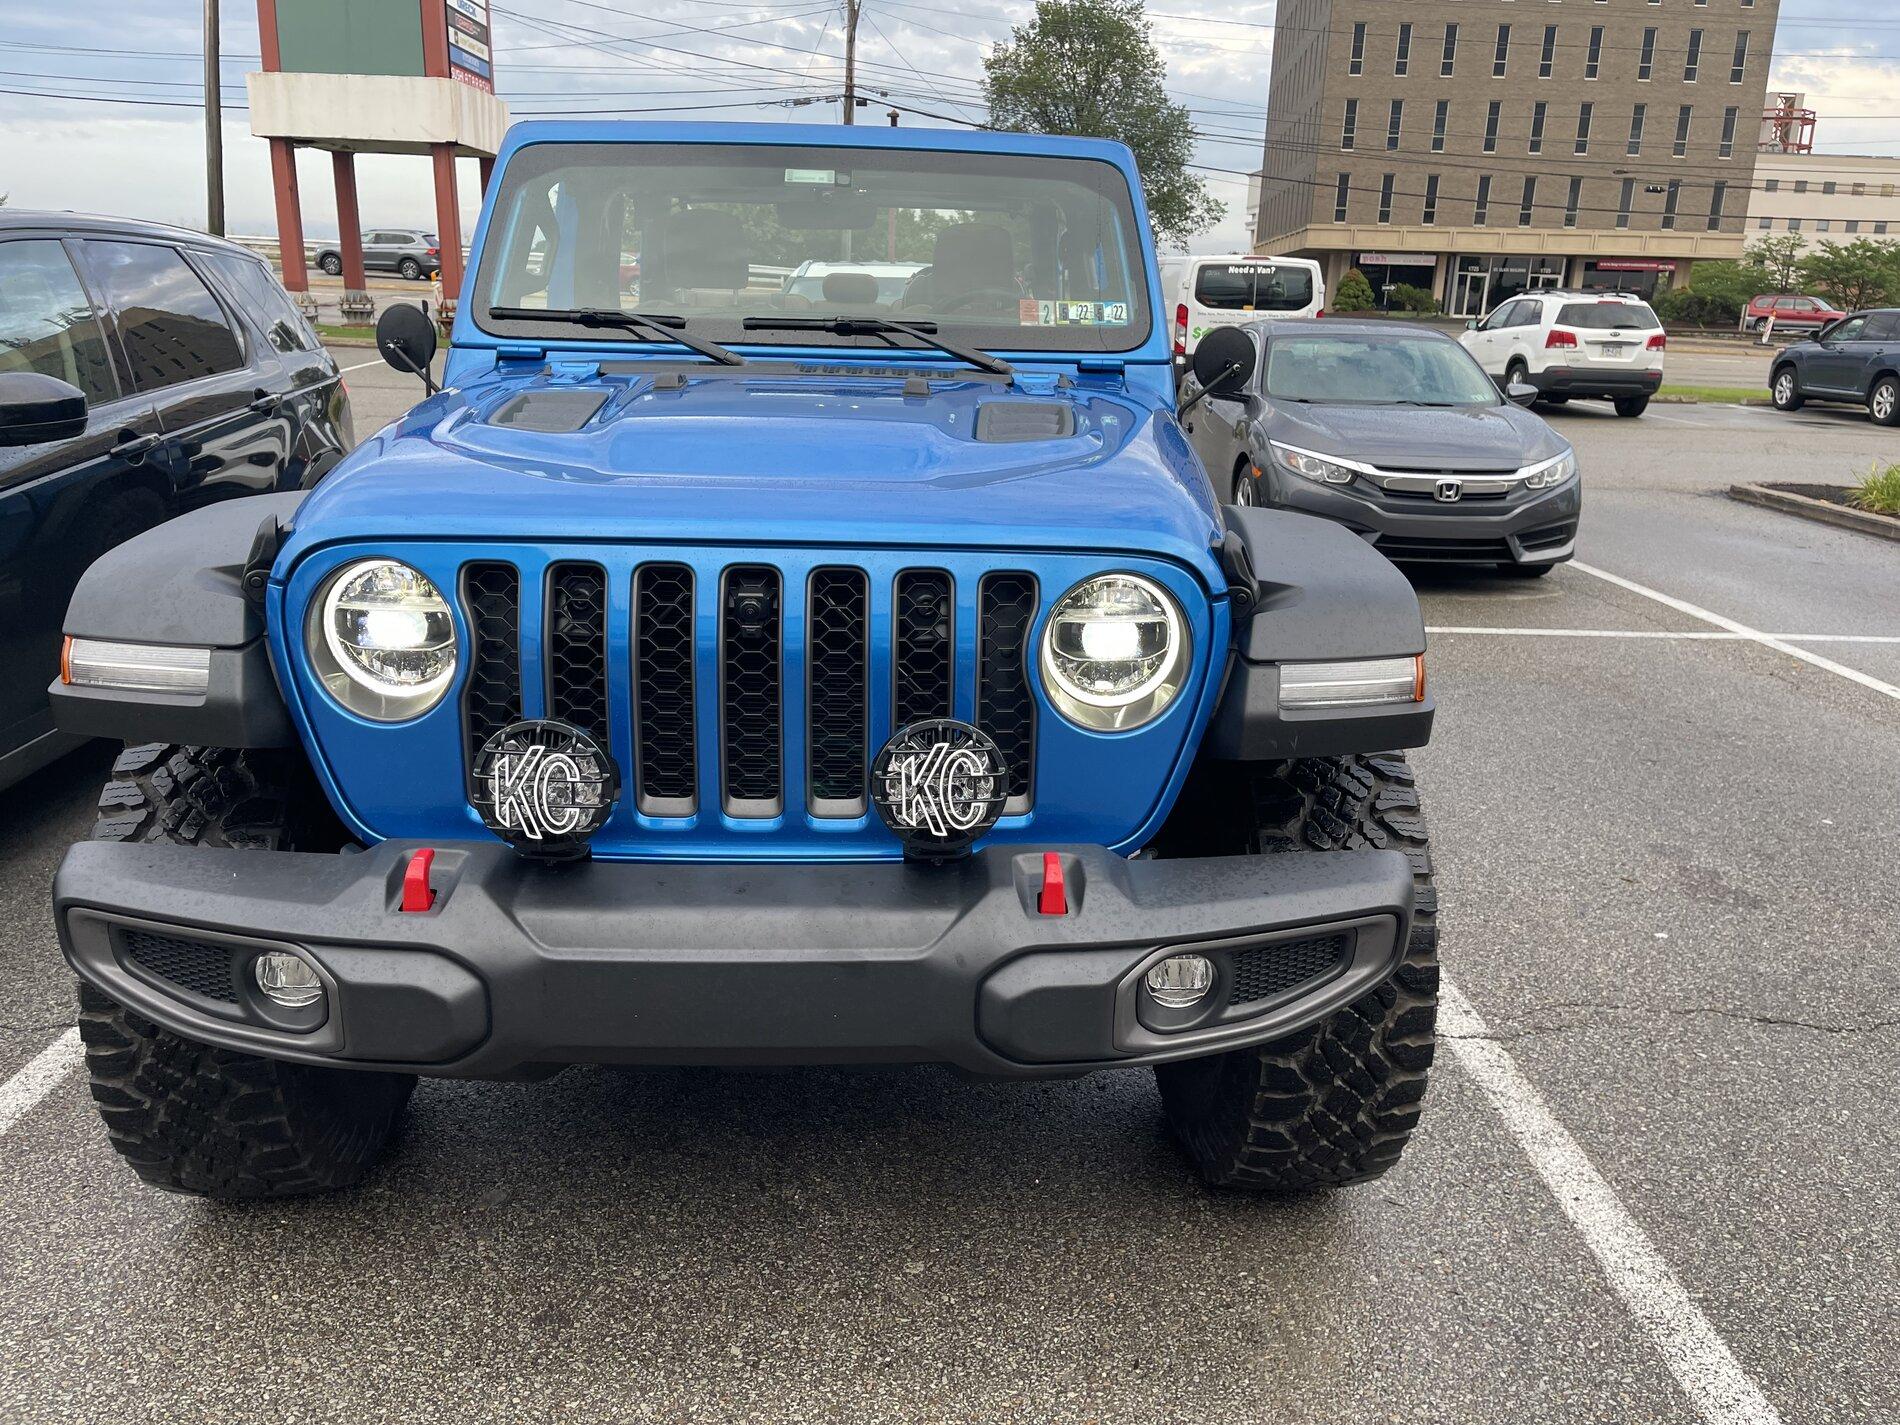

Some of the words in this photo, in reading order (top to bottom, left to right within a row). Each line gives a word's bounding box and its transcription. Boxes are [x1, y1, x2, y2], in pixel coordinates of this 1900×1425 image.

[1228, 265, 1249, 274] Need
[1257, 266, 1276, 274] Van?
[1077, 304, 1089, 320] 22
[1113, 304, 1124, 320] 22
[495, 745, 581, 839] KC
[901, 742, 984, 836] KC
